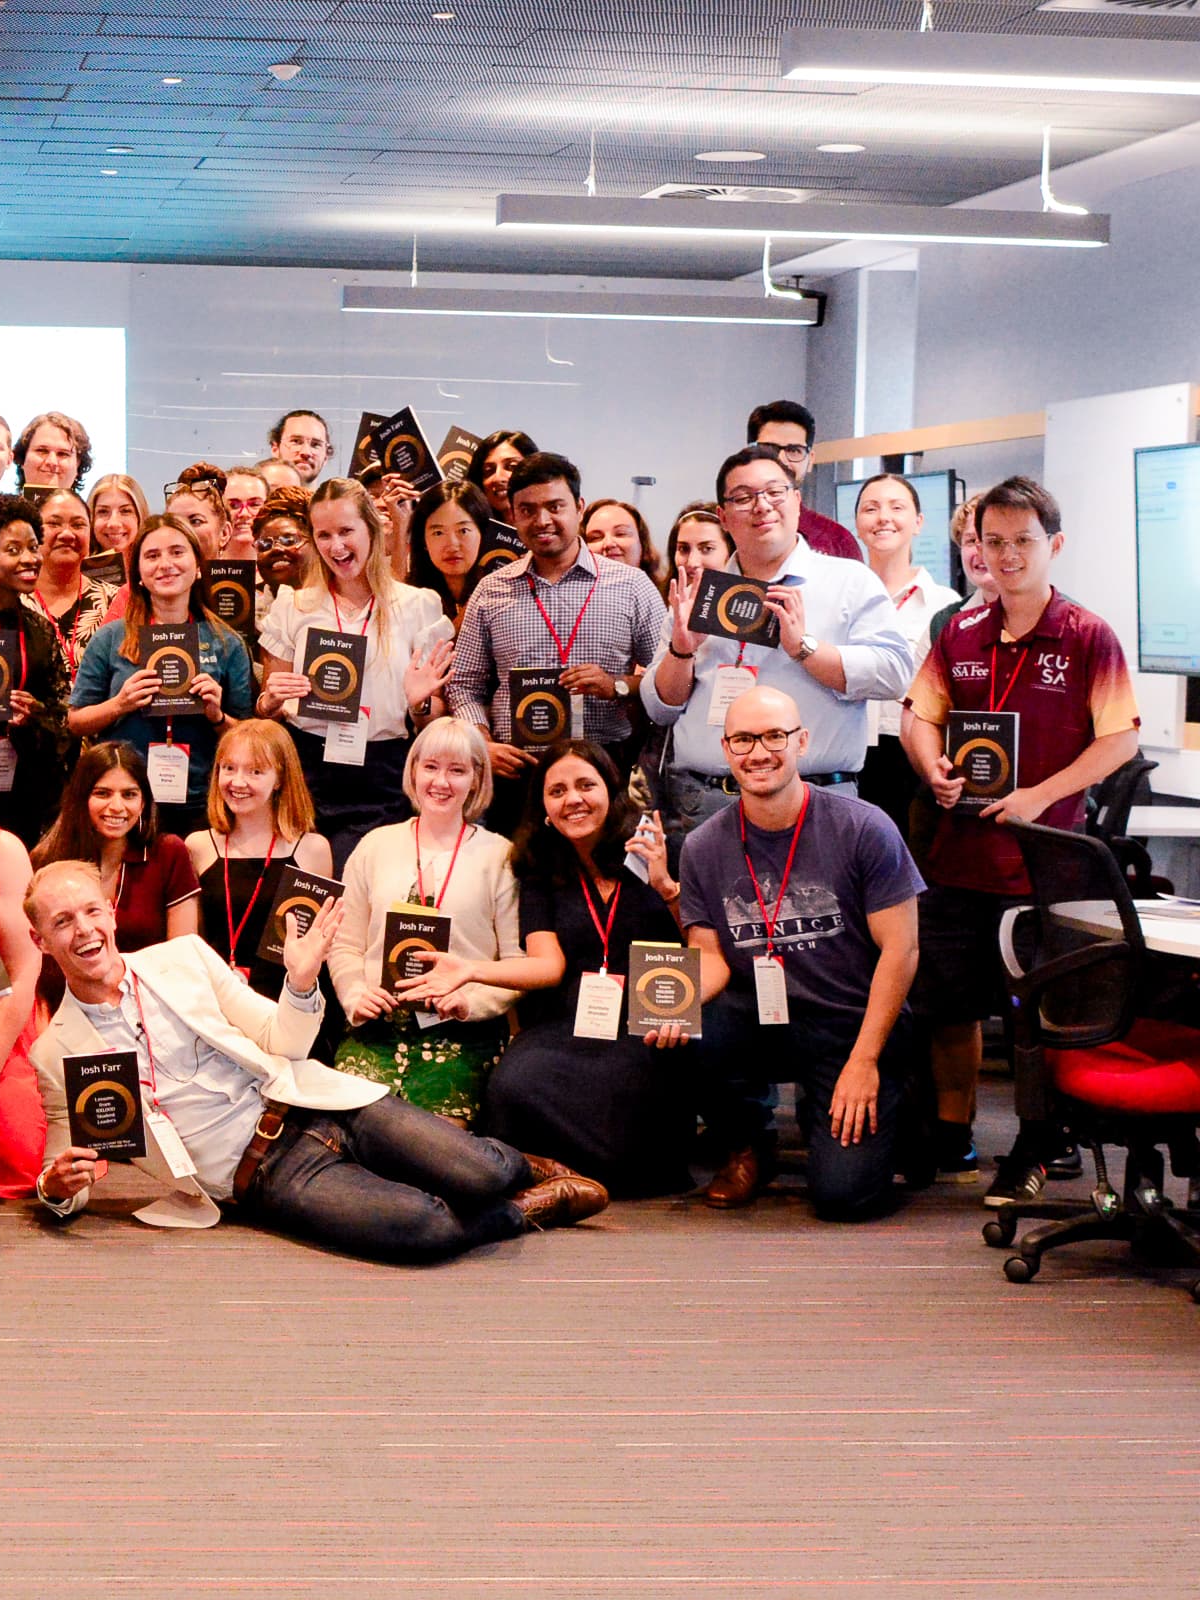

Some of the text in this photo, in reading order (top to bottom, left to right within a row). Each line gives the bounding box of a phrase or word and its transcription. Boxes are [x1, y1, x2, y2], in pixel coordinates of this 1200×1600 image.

[456, 436, 478, 452] Josh Fa
[495, 532, 511, 544] Josh
[211, 567, 243, 576] Josh Farr
[699, 584, 716, 620] Josh Farr
[152, 633, 186, 642] Josh Farr
[319, 637, 353, 650] Josh Farr
[970, 665, 989, 677] Fee
[522, 677, 556, 687] Josh Farr
[1041, 669, 1066, 686] SA
[963, 722, 1000, 732] Josh Farr
[294, 879, 329, 897] Josh Farr
[399, 921, 436, 933] Josh Farr
[729, 914, 844, 941] VENICE
[770, 940, 817, 953] EACH
[644, 953, 685, 963] Josh Farr
[81, 1063, 122, 1077] Josh Farr
